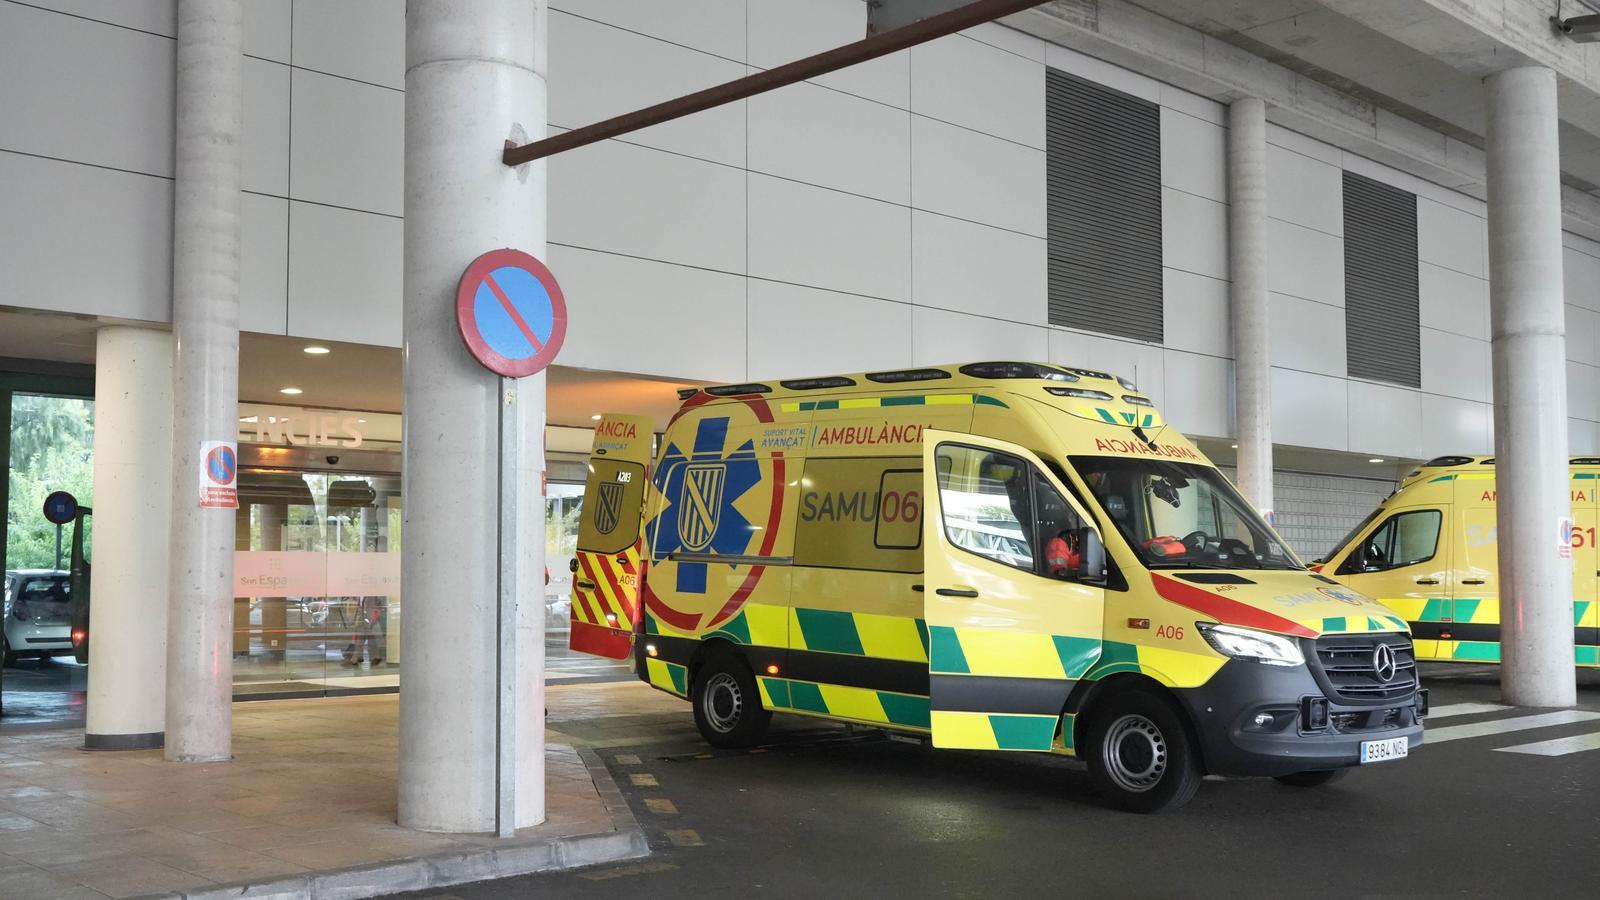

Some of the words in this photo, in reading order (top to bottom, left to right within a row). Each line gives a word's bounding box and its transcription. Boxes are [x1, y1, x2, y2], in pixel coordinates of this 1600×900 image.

[818, 421, 933, 445] AMBULÀNCI
[762, 437, 805, 448] AVANÇAT
[259, 574, 289, 589] Espa
[619, 575, 635, 585] A06
[1156, 624, 1184, 640] A06
[1368, 743, 1390, 759] 9384
